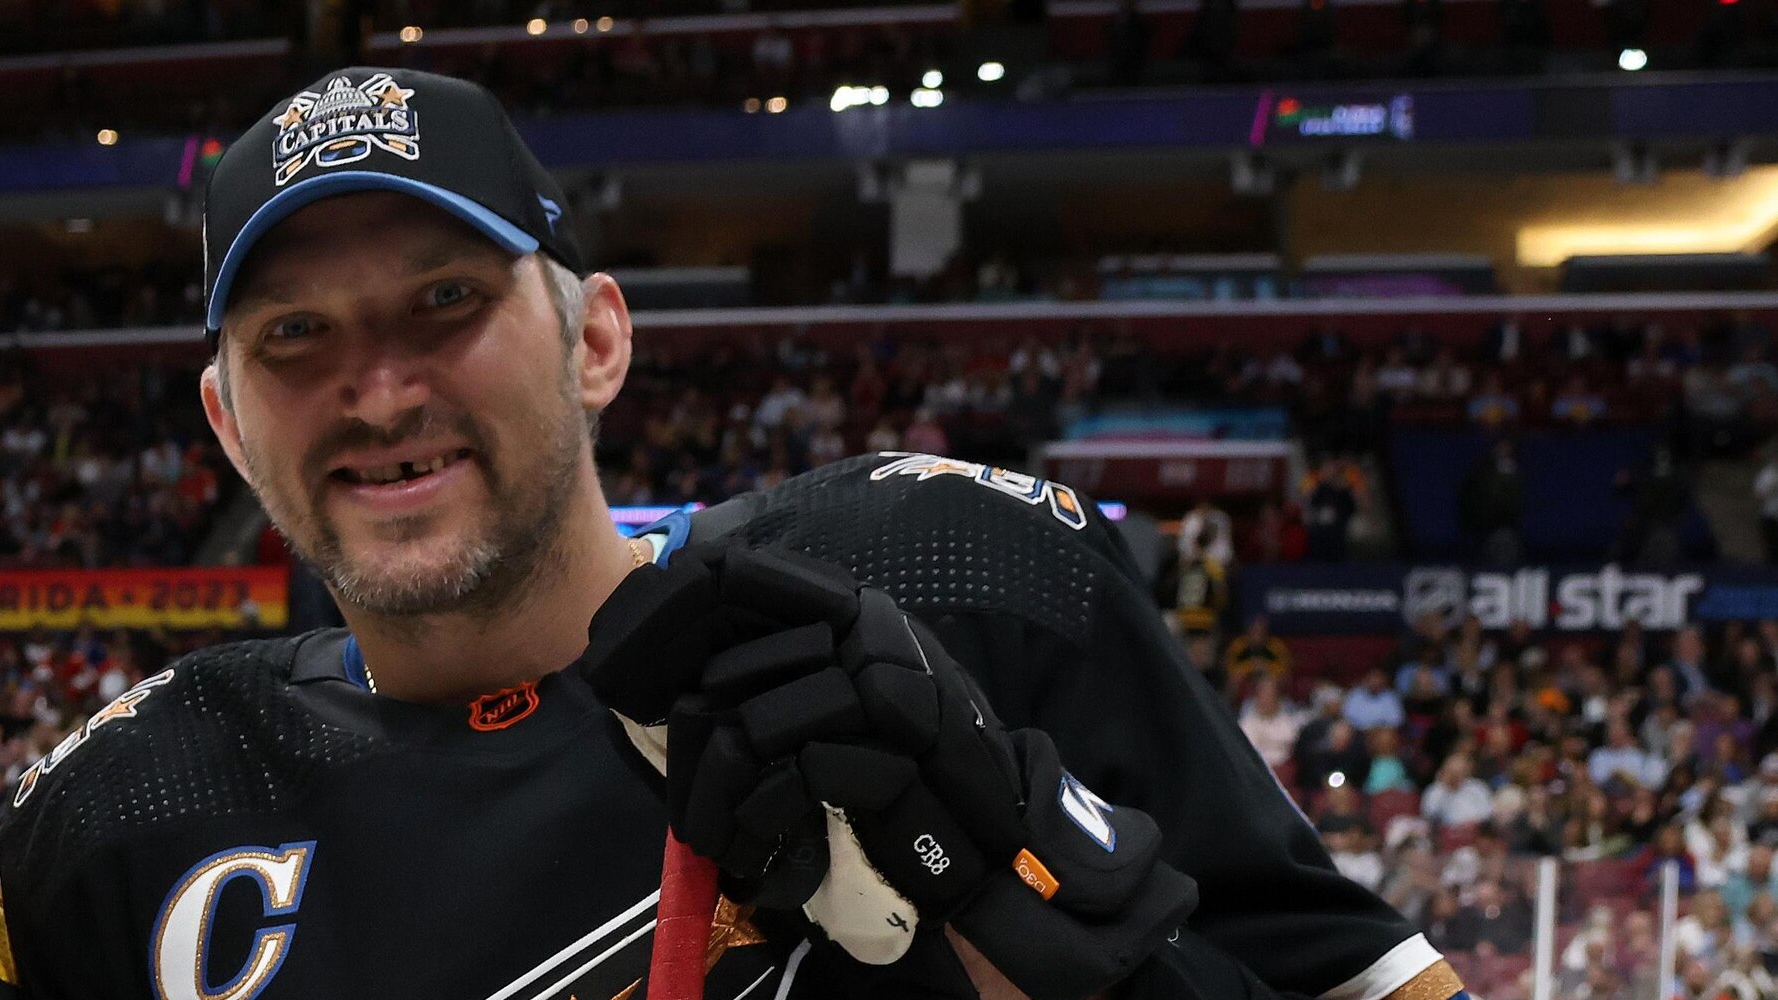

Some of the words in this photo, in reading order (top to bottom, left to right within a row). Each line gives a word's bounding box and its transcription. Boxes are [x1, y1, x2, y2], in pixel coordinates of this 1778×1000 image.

[280, 109, 410, 155] CAPITALS
[1469, 567, 1550, 629] all
[1556, 563, 1703, 630] star
[913, 833, 951, 876] GR8
